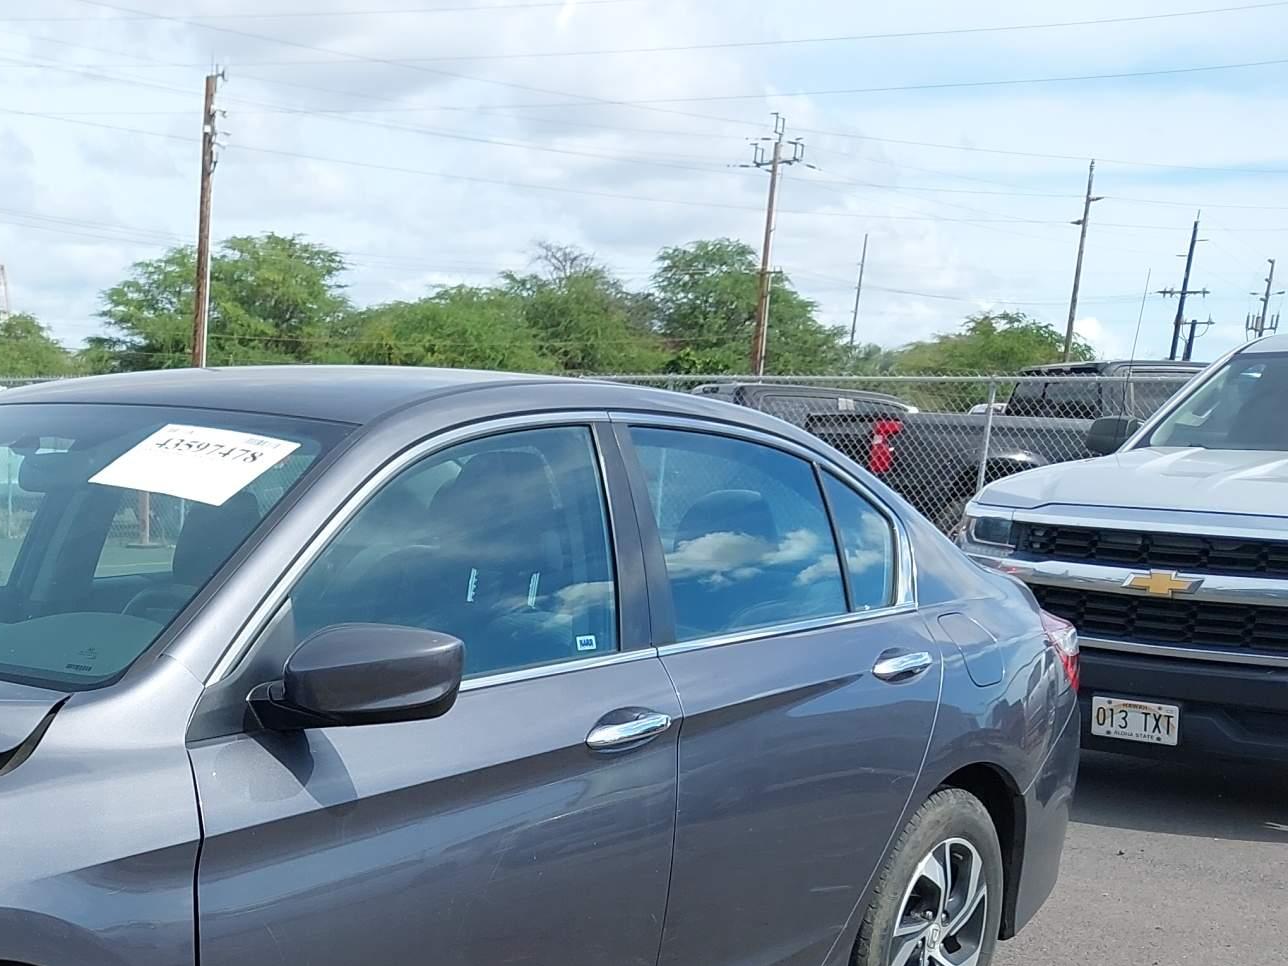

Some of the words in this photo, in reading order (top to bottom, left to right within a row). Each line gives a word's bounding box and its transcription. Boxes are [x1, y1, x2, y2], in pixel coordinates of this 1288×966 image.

[155, 438, 264, 463] 43597478
[1096, 706, 1129, 730] 013
[1142, 712, 1174, 735] TXT
